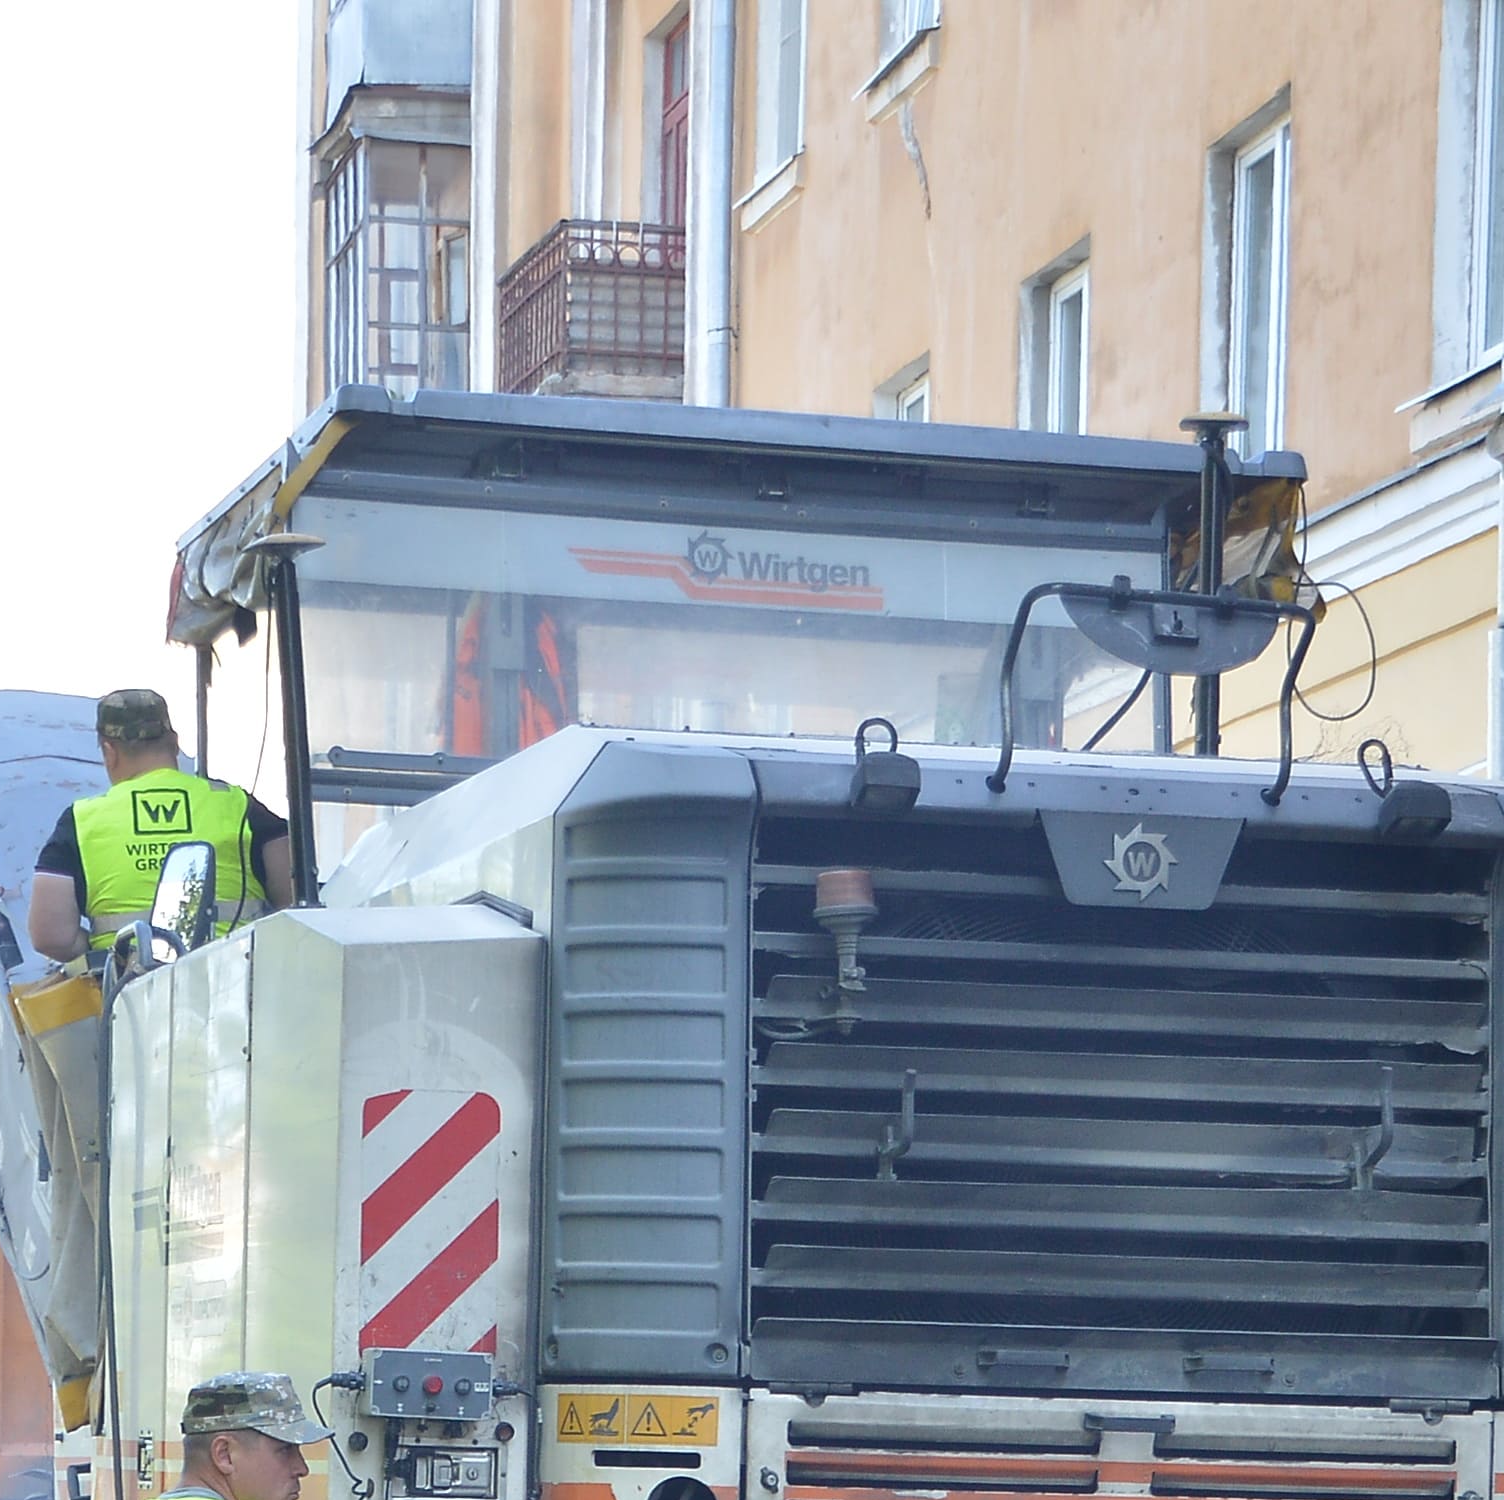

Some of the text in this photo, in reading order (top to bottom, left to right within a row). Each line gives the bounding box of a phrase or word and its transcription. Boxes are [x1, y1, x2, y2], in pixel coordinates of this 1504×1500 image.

[697, 551, 870, 592] W Wirtgen
[140, 800, 181, 823] W
[126, 842, 176, 856] WIRT
[1127, 852, 1156, 877] W
